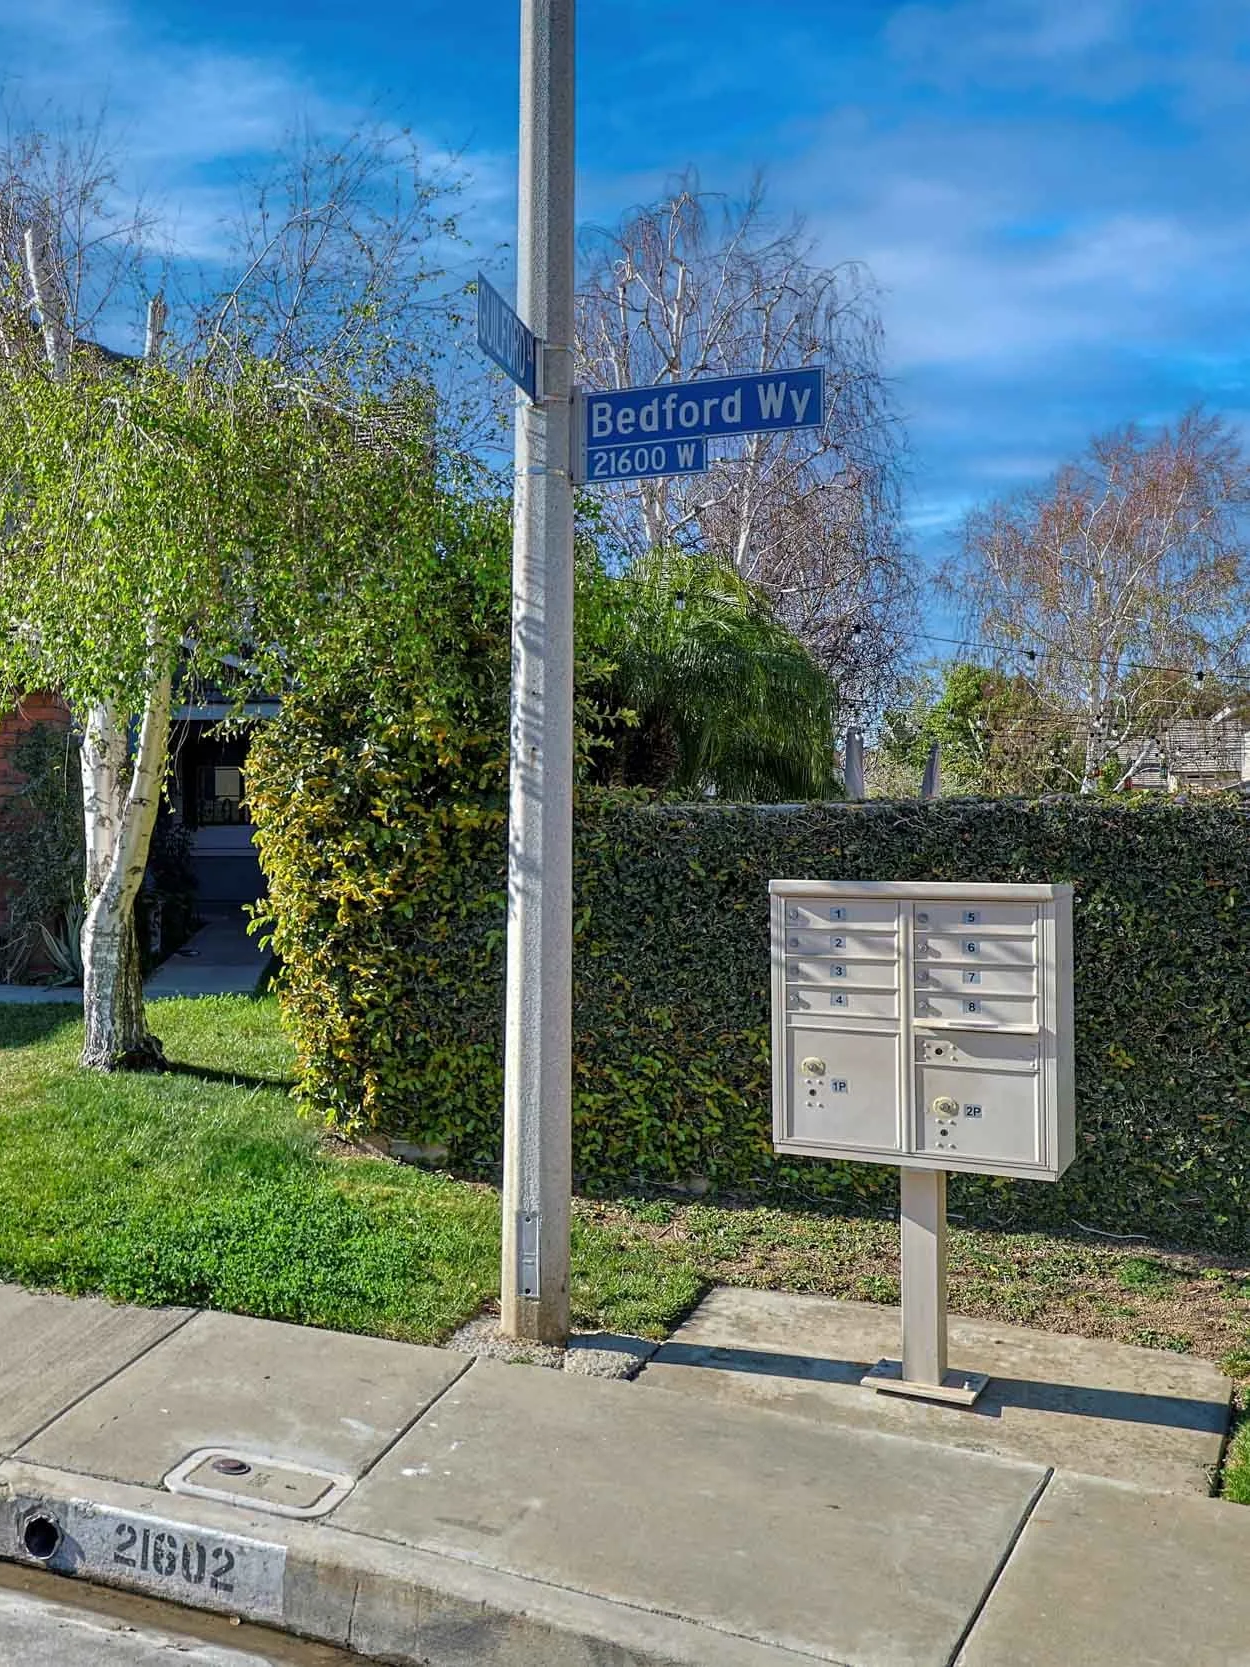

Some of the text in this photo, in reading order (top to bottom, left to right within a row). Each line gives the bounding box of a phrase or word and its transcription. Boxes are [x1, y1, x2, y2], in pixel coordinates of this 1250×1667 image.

[592, 381, 812, 438] Bedford Wy
[593, 443, 696, 476] 21600 W
[967, 912, 975, 922] 5
[834, 937, 843, 948] 2
[967, 942, 975, 952] 6
[835, 966, 843, 976] 3
[967, 972, 976, 983] 7
[835, 994, 843, 1004] 4
[967, 1002, 976, 1012] 8
[832, 1081, 847, 1092] 1P
[966, 1106, 982, 1117] 2P
[113, 1522, 236, 1593] 21602
